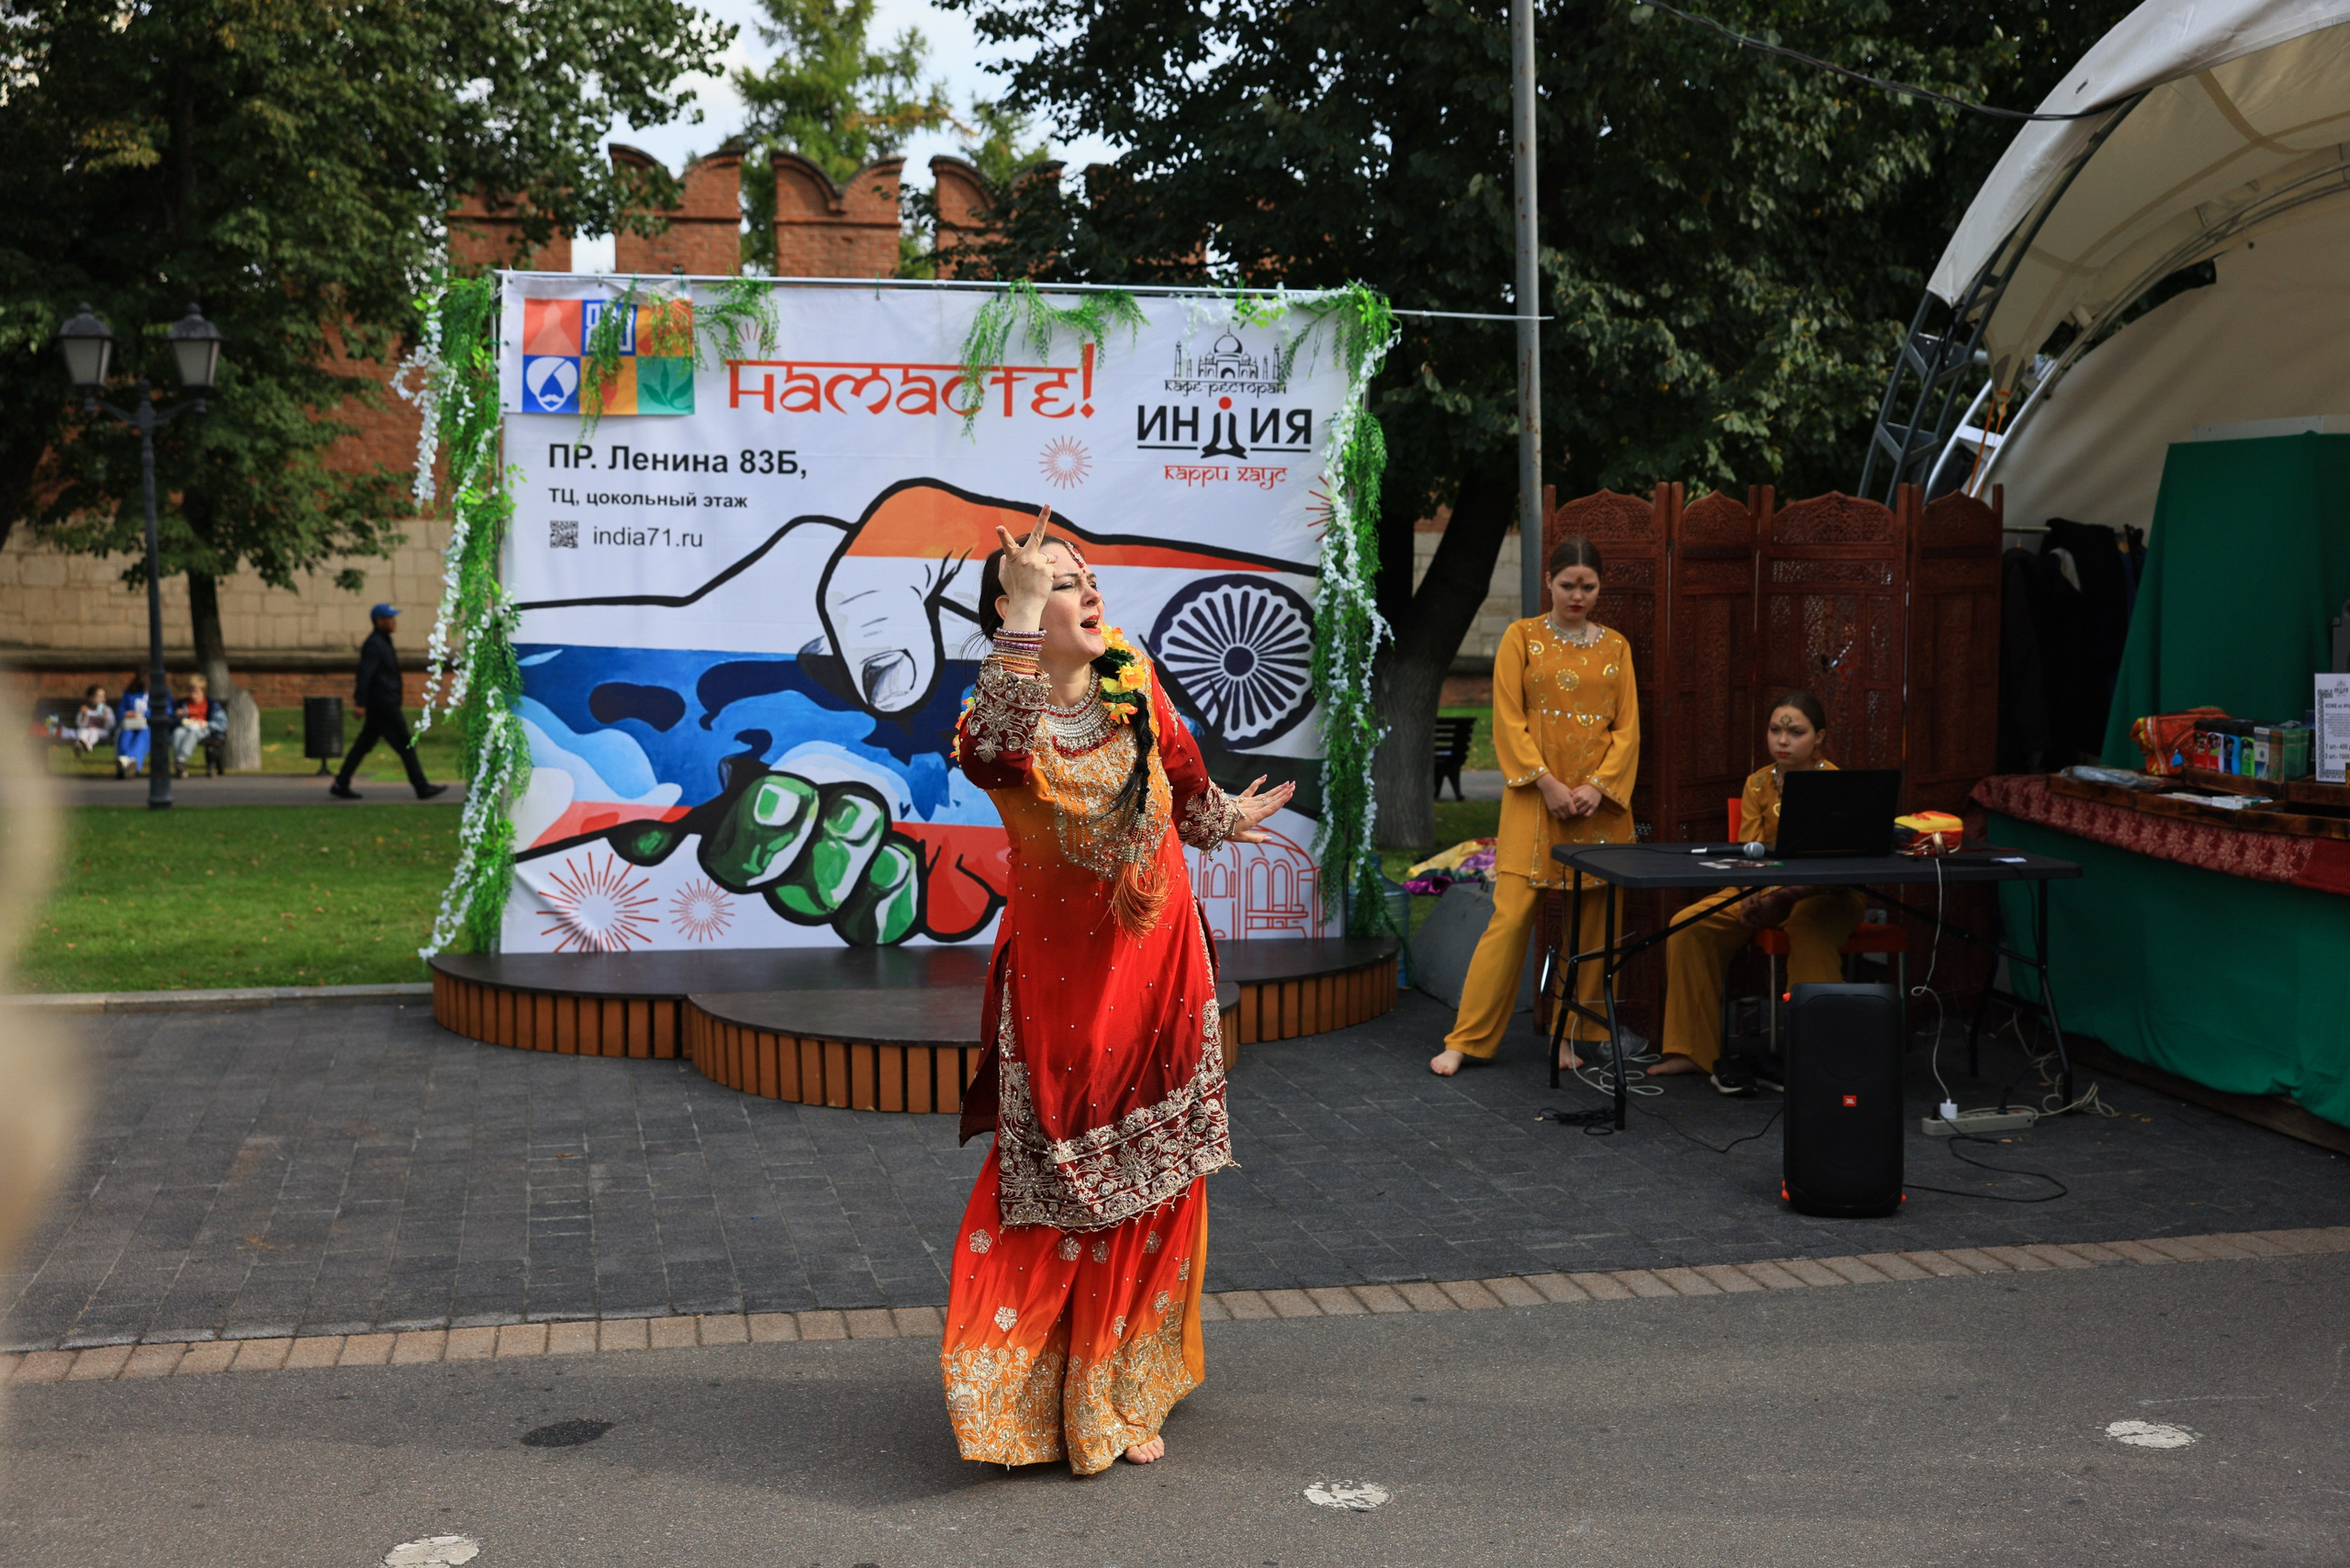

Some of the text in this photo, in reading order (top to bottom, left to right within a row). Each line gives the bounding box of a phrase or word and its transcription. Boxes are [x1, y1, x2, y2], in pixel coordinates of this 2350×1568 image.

[724, 342, 1095, 419] Намасте!
[1137, 398, 1313, 459] ИНДИЯ
[549, 443, 807, 479] ПР. Ленина 83Б,
[1164, 465, 1288, 490] карри хаус
[548, 487, 748, 508] ТЦ, цокольный этаж
[592, 527, 703, 547] india71.ru
